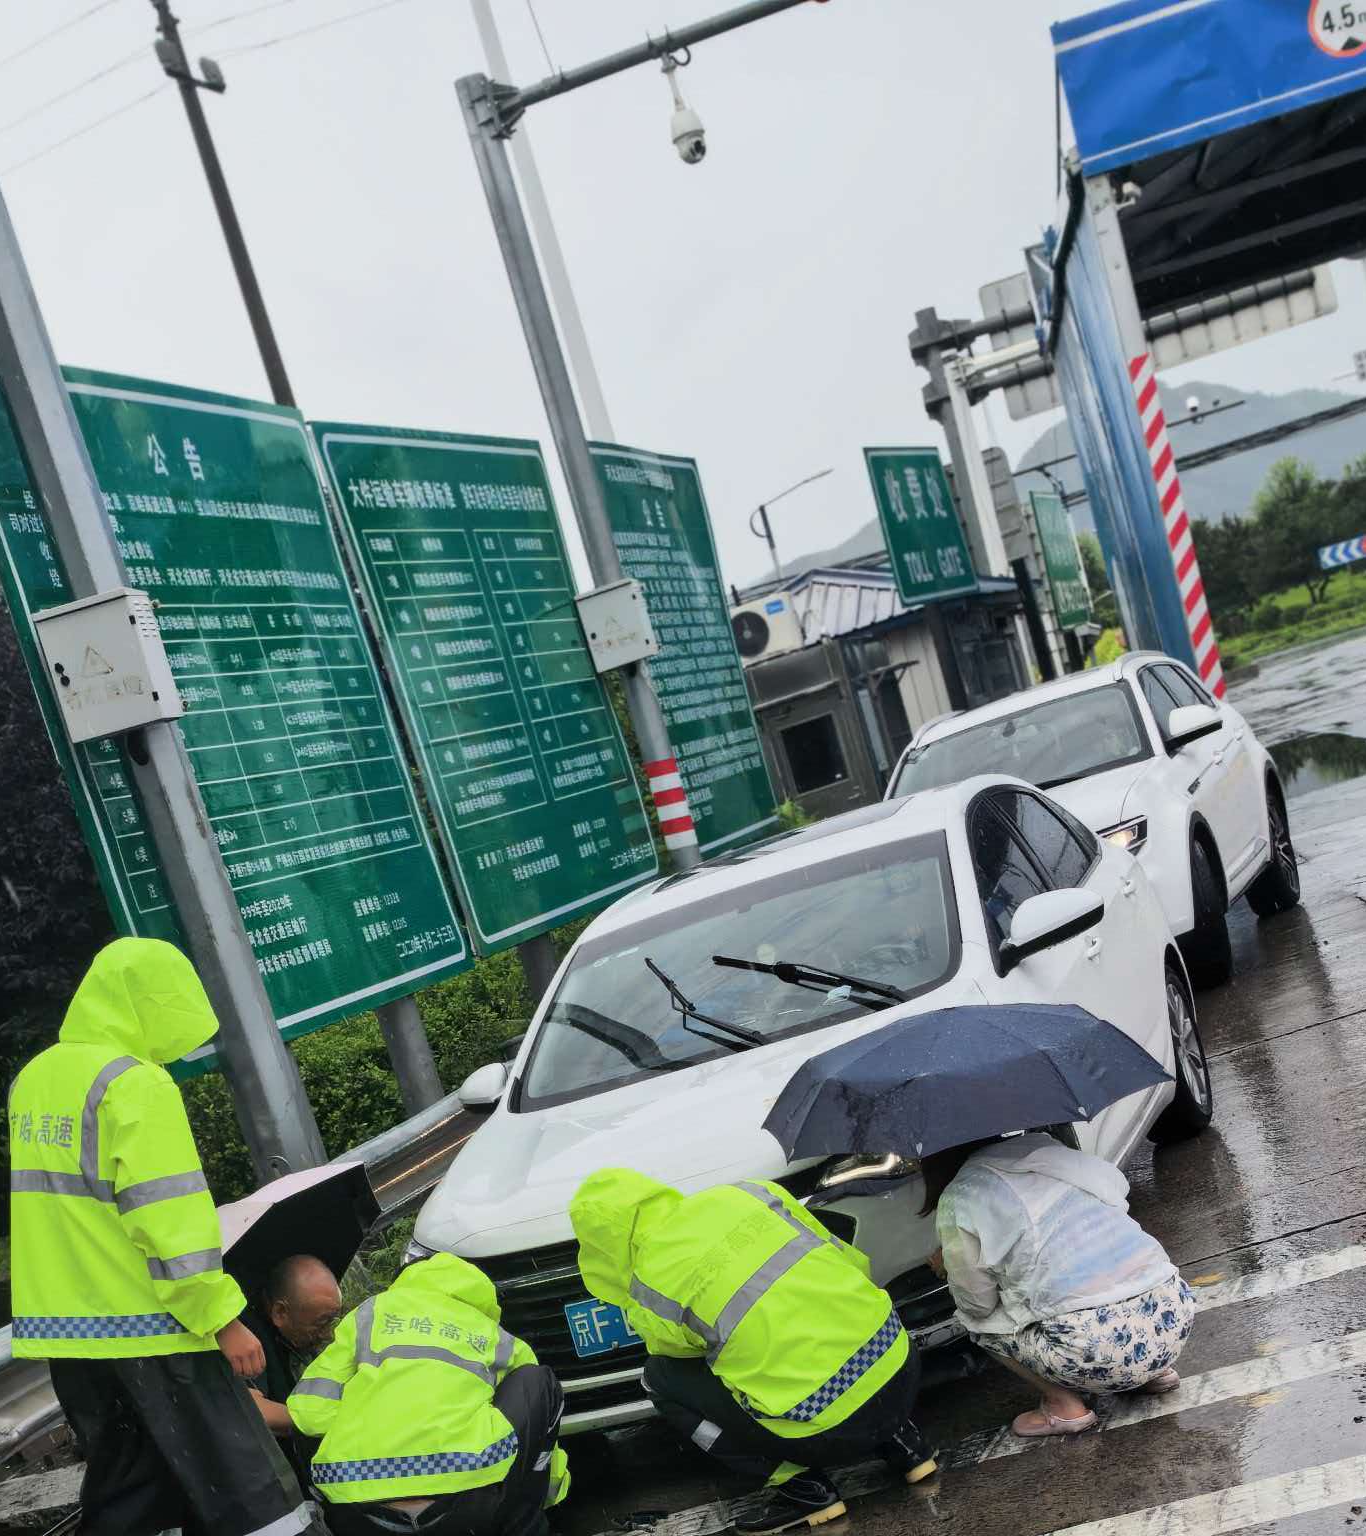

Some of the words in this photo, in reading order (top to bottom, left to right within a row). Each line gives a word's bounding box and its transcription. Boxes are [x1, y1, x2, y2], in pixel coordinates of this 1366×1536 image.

[147, 434, 206, 481] 公告
[381, 1312, 490, 1355] 京哈高速
